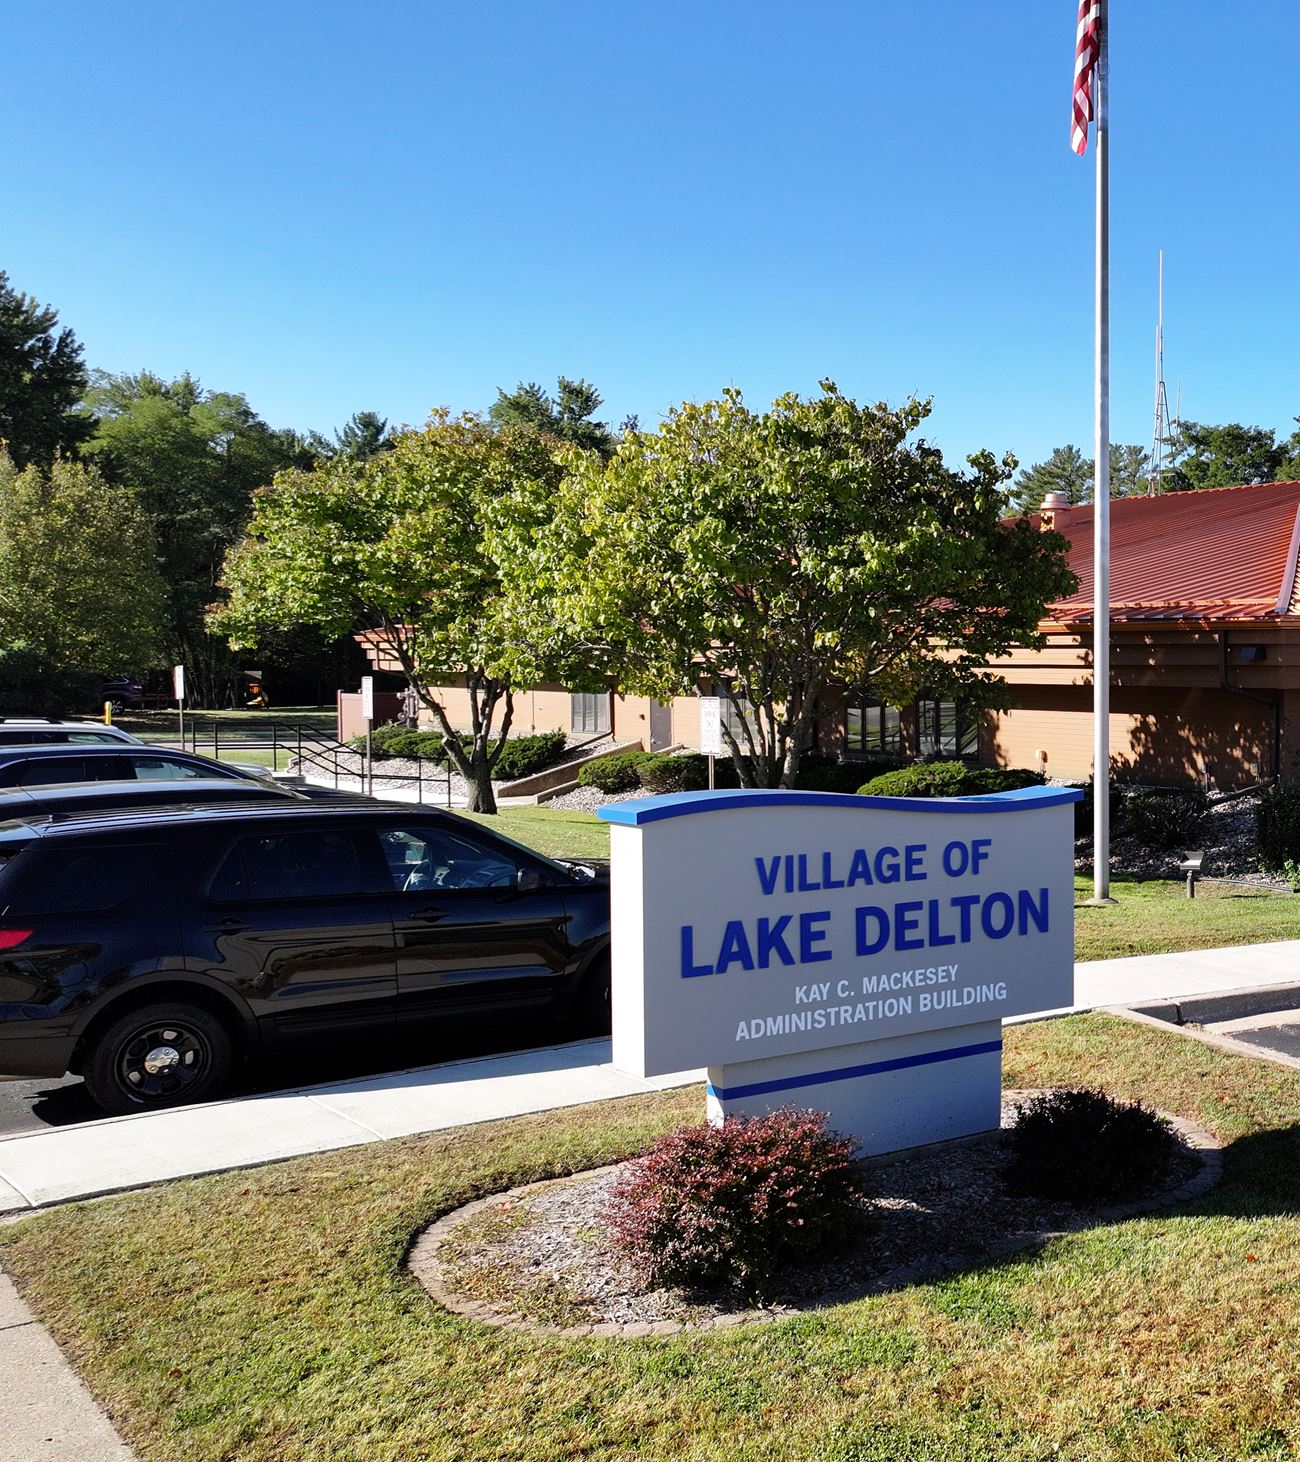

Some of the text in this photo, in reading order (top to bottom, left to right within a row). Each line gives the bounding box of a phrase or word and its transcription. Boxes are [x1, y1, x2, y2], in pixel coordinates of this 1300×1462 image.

[754, 838, 992, 896] VILLAGE OF
[680, 887, 1050, 978] LAKE DELTON
[735, 982, 1007, 1041] ADMINISTRATION BUILDING
[795, 964, 959, 1004] KAY C. MACKESEY
